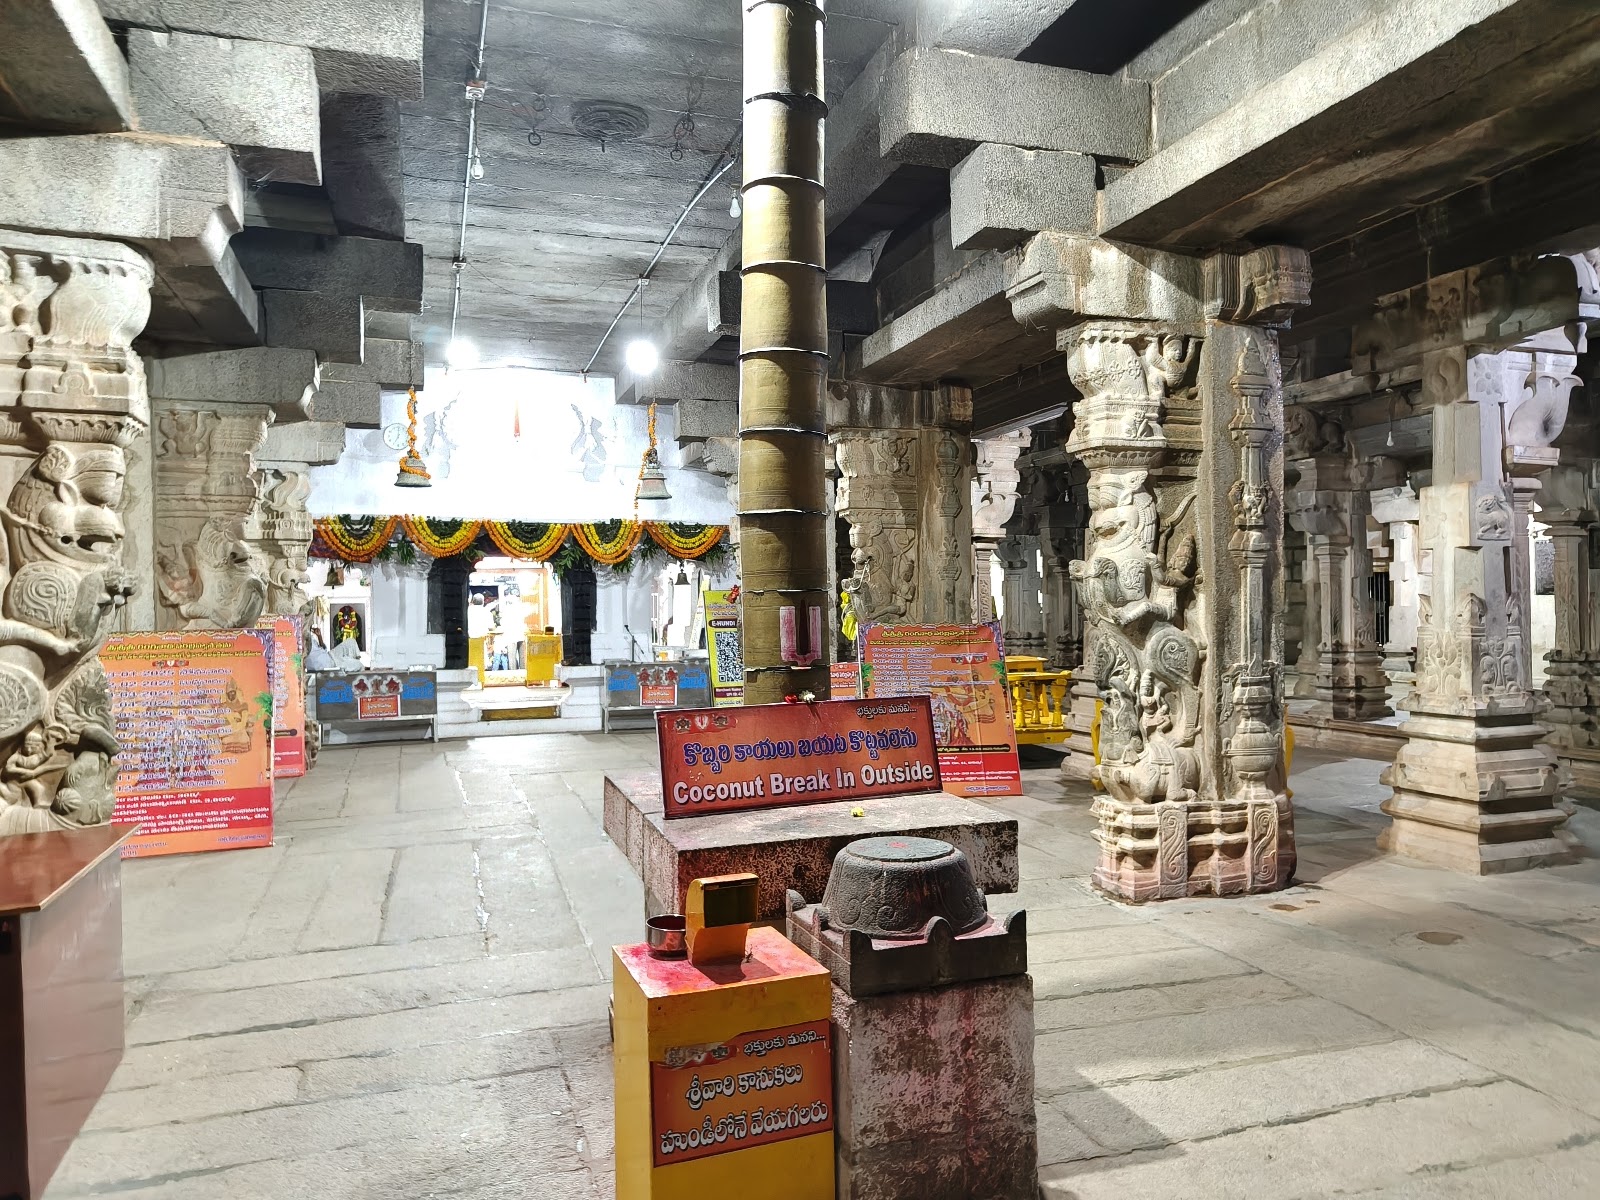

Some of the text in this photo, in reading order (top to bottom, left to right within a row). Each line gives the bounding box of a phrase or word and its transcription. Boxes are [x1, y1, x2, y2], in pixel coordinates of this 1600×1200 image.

[856, 704, 888, 719] భక్తులకు
[683, 727, 918, 773] కొబ్బరి కాయలు బయట కొట్టవలెను
[673, 776, 765, 804] Coconut
[769, 770, 831, 795] Break
[836, 767, 856, 788] In
[860, 760, 934, 786] Outside
[743, 1036, 787, 1056] భక్తులకు
[685, 1063, 803, 1110] శ్రీవారి కానుకలు
[660, 1100, 829, 1154] హుండీలోనే వేయగలరు
